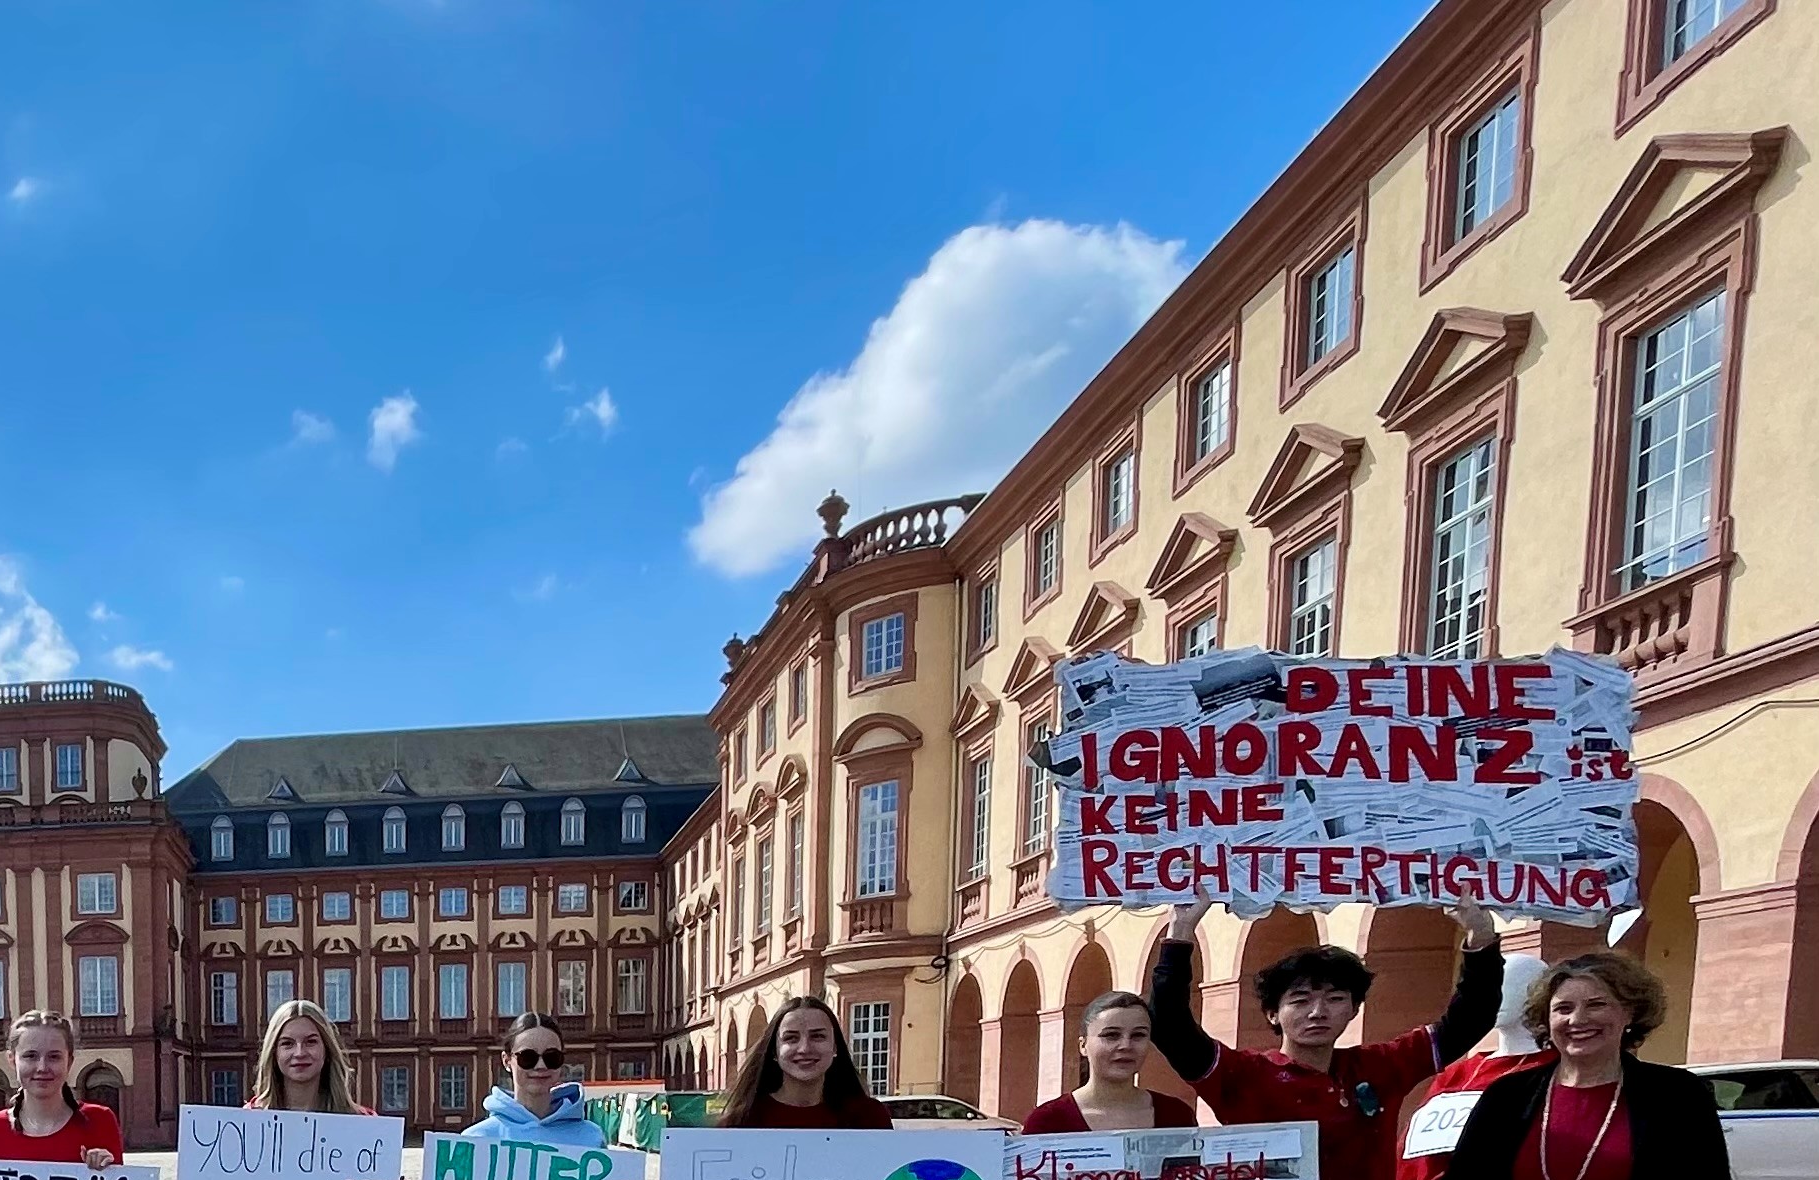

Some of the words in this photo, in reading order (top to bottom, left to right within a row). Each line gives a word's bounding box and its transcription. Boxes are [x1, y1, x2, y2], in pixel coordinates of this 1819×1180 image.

[1287, 664, 1556, 721] DEINE
[1080, 722, 1542, 791] IGNORANZ
[1566, 743, 1634, 783] ist
[1079, 783, 1285, 836] KEINE
[297, 1118, 343, 1174] die
[357, 1138, 384, 1173] of
[1421, 1106, 1473, 1133] 202
